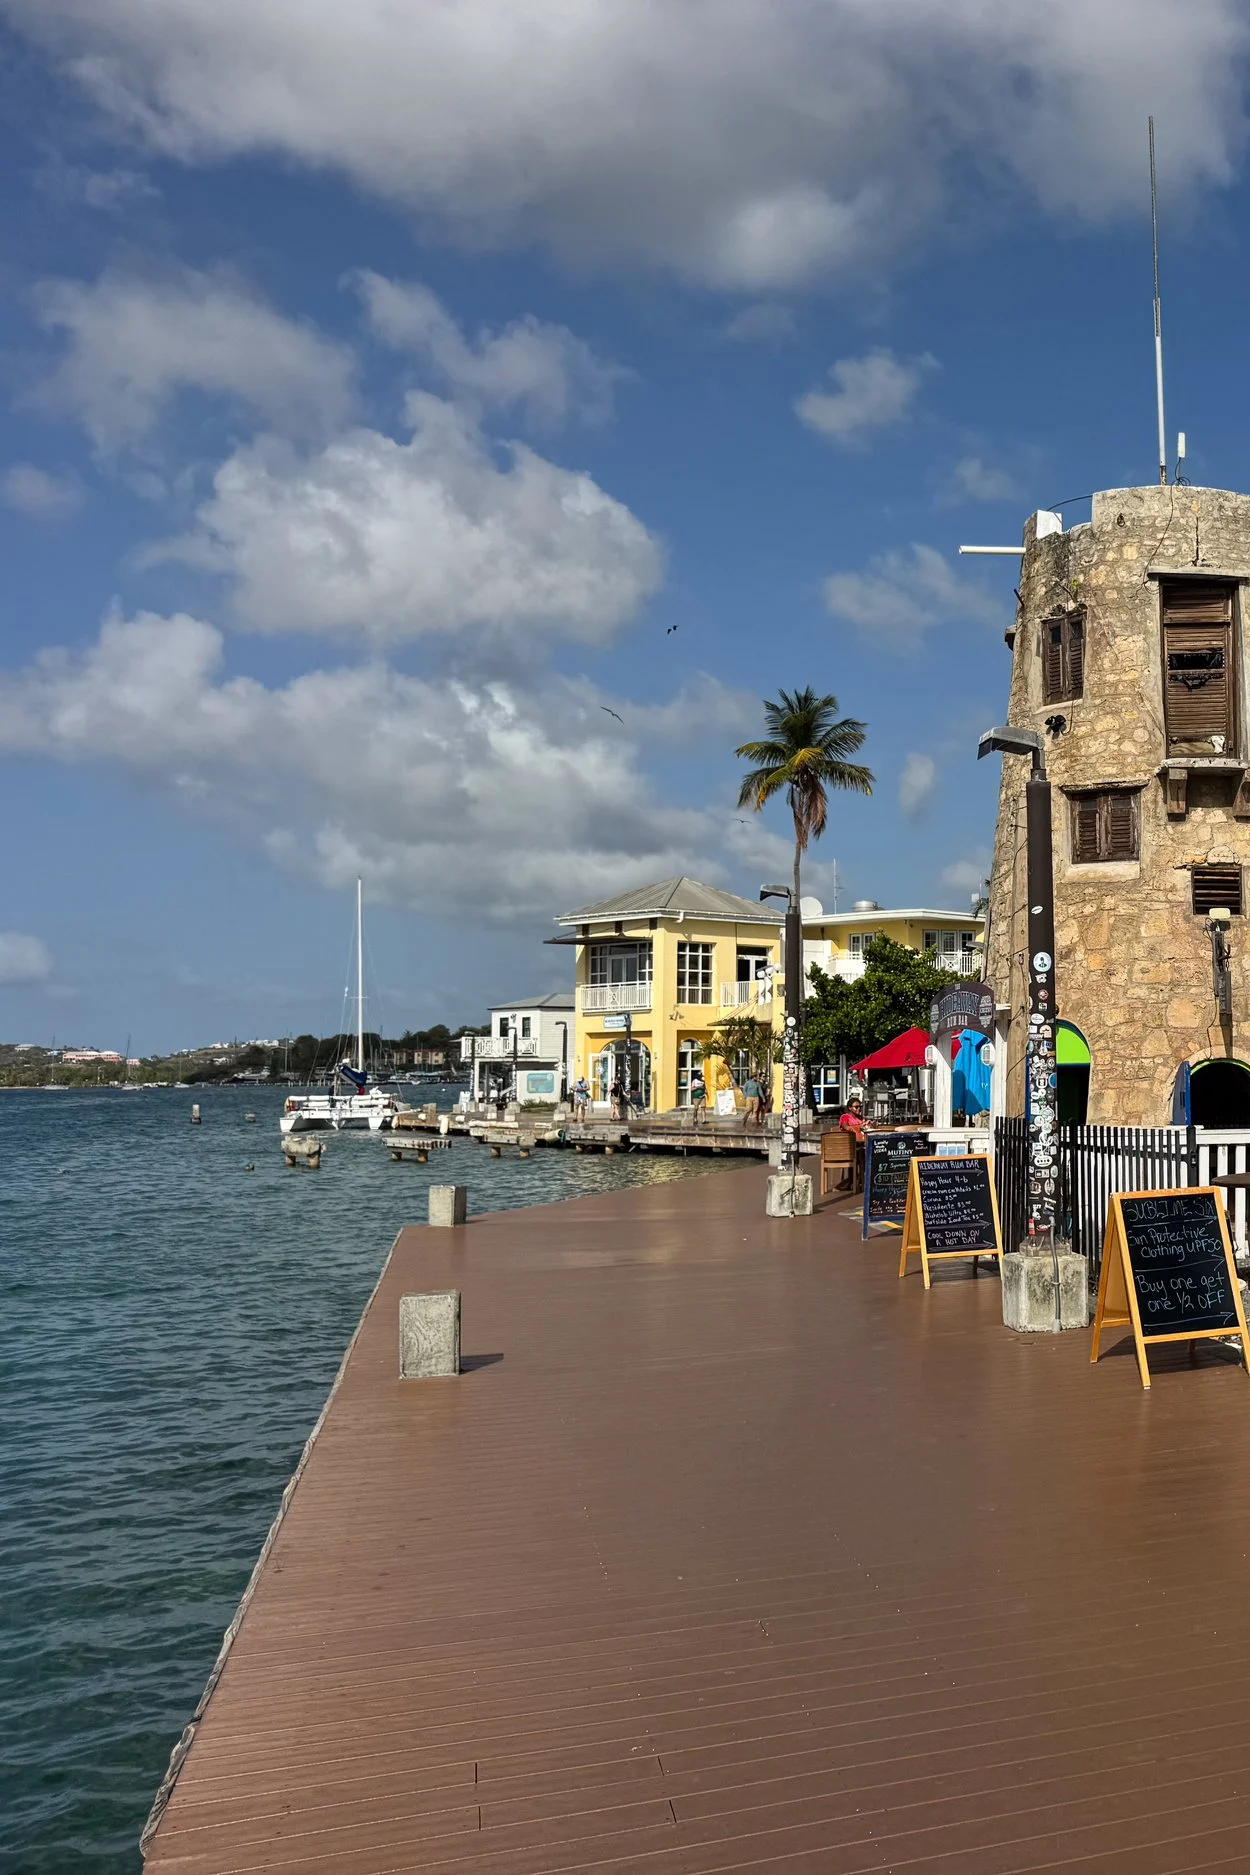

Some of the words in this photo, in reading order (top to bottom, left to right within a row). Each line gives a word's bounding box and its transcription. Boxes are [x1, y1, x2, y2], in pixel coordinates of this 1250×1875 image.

[939, 991, 979, 1022] HIDEAWAY
[919, 1161, 948, 1170] HIDEAWAY
[950, 1161, 965, 1169] RUM
[966, 1160, 980, 1168] BAR
[920, 1177, 938, 1188] Happy
[938, 1176, 952, 1185] Hour
[1124, 1200, 1193, 1222] SUBLIME
[927, 1231, 943, 1240] COOL
[945, 1230, 967, 1238] DOWN
[969, 1229, 980, 1237] ON
[945, 1238, 958, 1246] HOT
[1128, 1230, 1149, 1247] Sun
[1147, 1225, 1209, 1243] Protective
[1141, 1244, 1186, 1262] Clothing
[1186, 1237, 1223, 1253] UPF50
[1135, 1274, 1168, 1301] Buy
[1170, 1277, 1198, 1290] one
[1201, 1271, 1225, 1294] get
[1147, 1300, 1177, 1313] one
[1197, 1289, 1225, 1309] OFF
